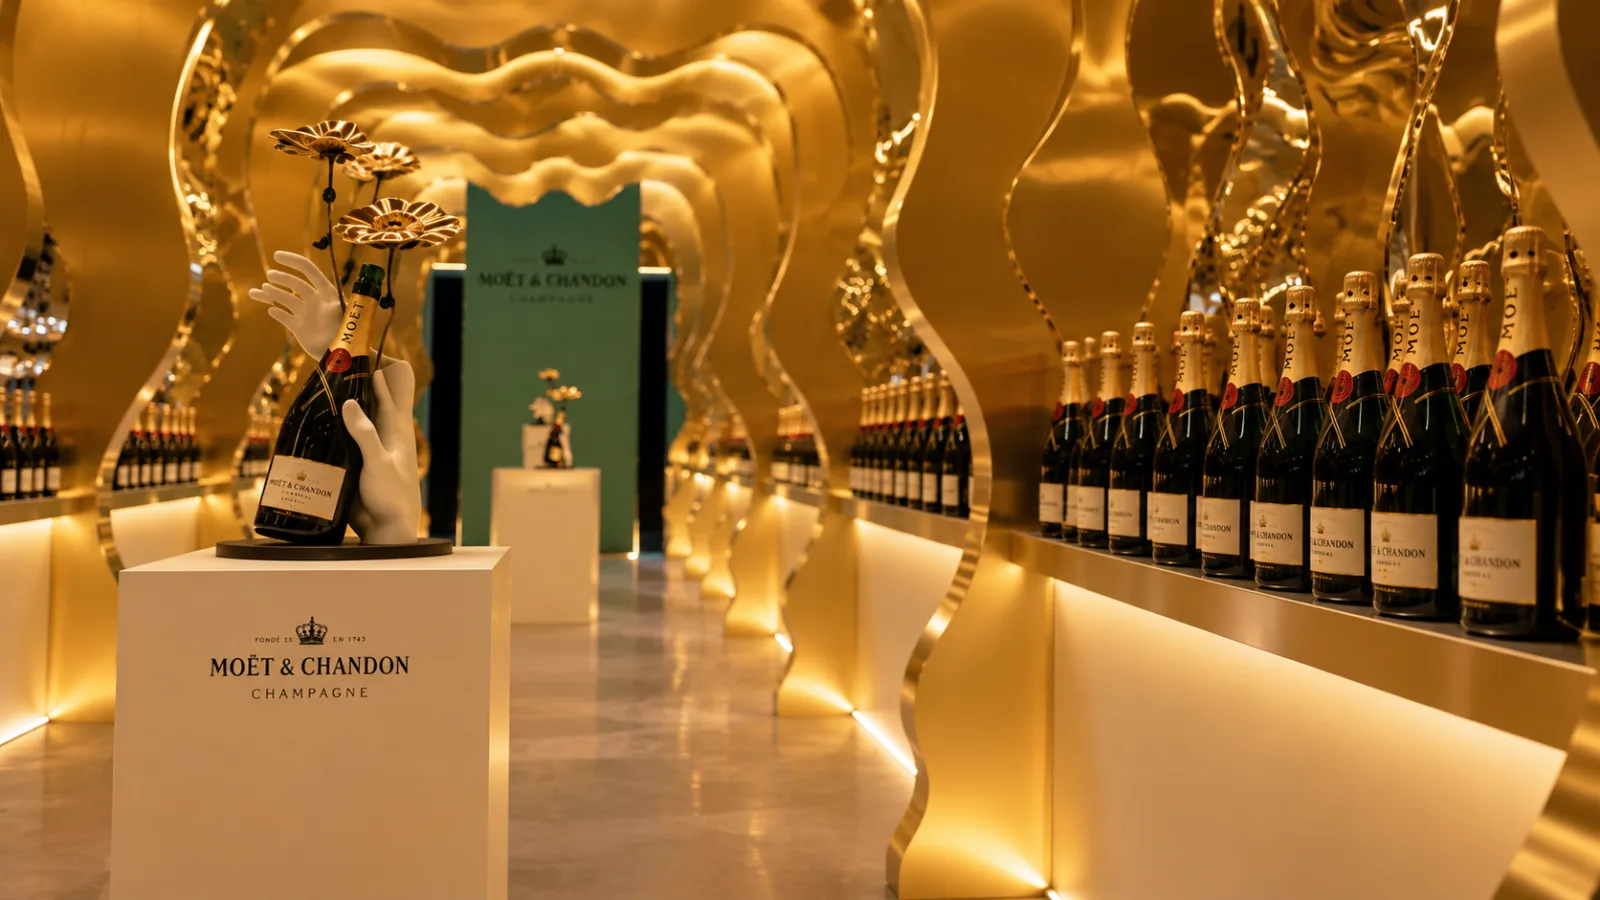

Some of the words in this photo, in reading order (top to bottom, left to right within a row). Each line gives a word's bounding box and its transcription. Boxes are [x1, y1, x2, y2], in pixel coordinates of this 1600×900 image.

[529, 272, 541, 288] &
[545, 271, 627, 288] CHANDON
[294, 483, 333, 499] CHANDON
[1382, 547, 1426, 559] CHANDON
[210, 653, 275, 677] MOËT
[280, 658, 295, 676] &
[301, 656, 409, 676] CHANDON
[251, 687, 368, 700] CHAMPAGNE
